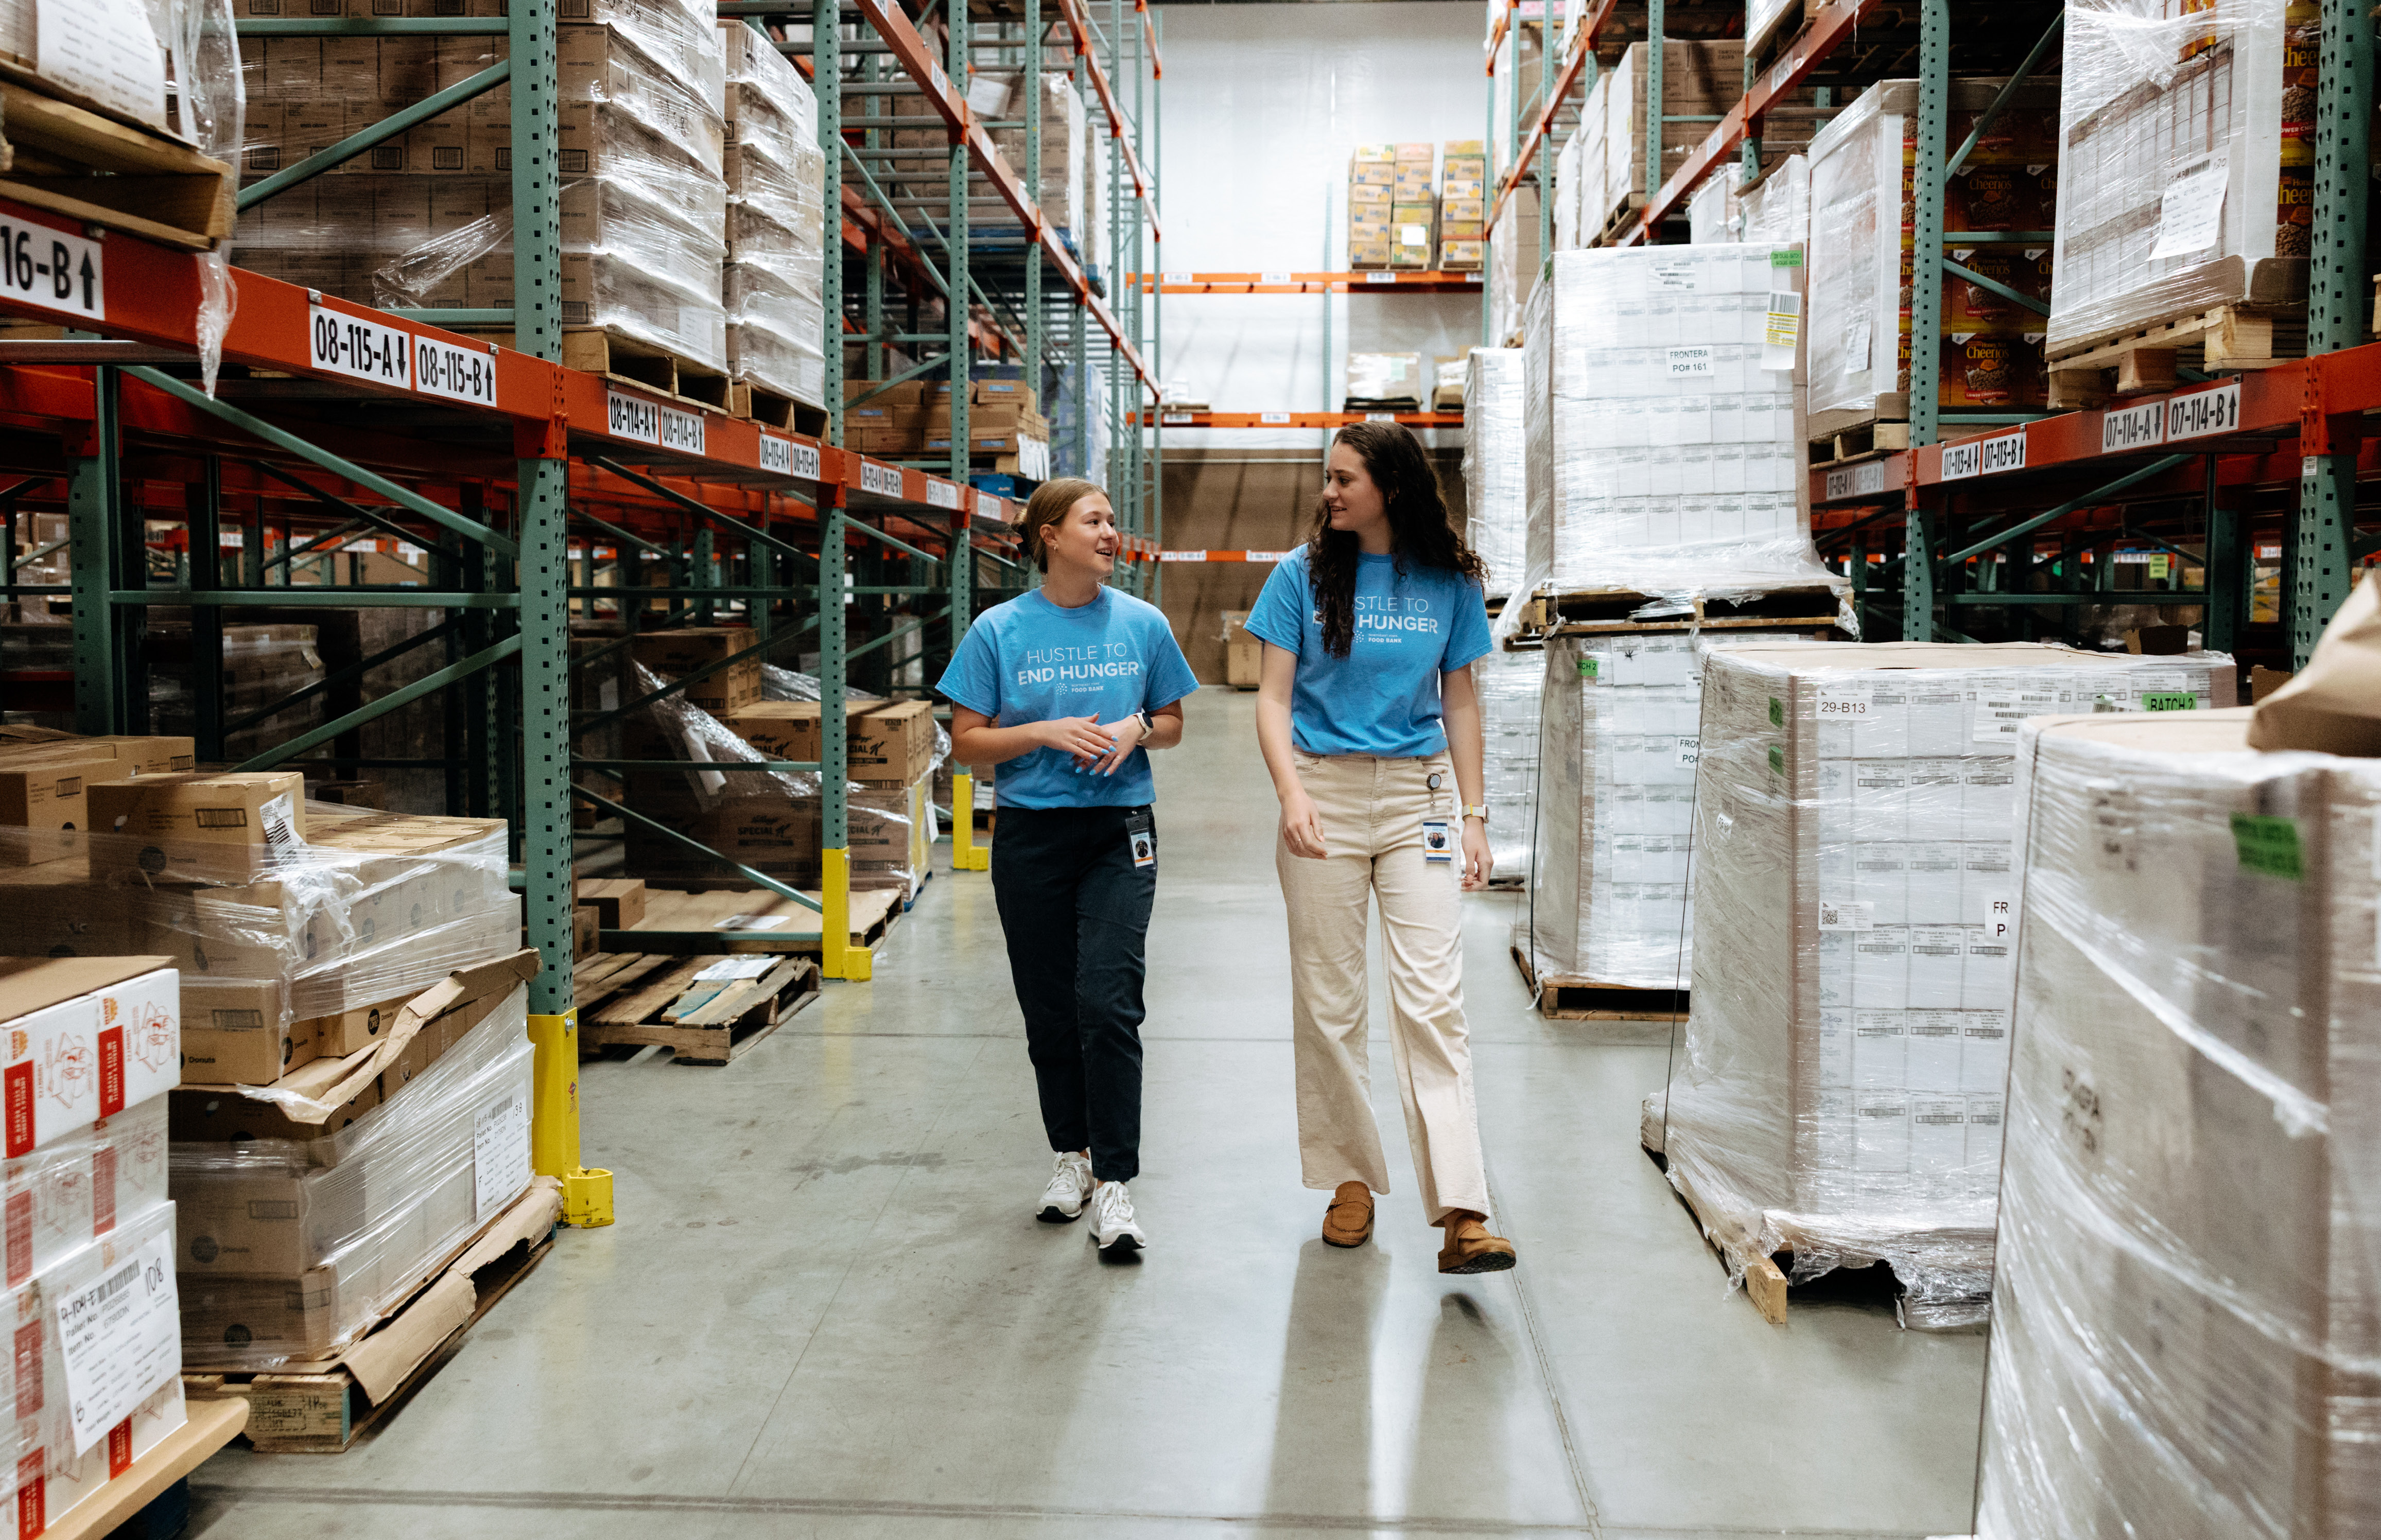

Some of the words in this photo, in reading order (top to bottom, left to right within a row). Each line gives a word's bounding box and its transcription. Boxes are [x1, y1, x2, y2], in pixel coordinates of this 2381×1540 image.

[1969, 178, 2012, 190] Cheerios
[2292, 178, 2312, 186] Hone
[1967, 262, 2010, 274] Cheerios
[316, 314, 393, 377] 08-115-A
[1670, 349, 1708, 359] FRONTERA
[1966, 346, 2009, 359] Cheerios
[419, 343, 482, 396] 08-115-B
[1673, 363, 1690, 372] PO#
[1693, 362, 1707, 371] 161
[610, 396, 651, 437] 08-114-A
[2171, 394, 2224, 436] 07-114-B
[663, 412, 697, 448] 08-114-B
[2106, 409, 2150, 447] 07-114-A
[761, 439, 785, 469] 08-113-A
[793, 446, 815, 474] 08-113-B
[1944, 448, 1972, 476] 07-113-A
[1985, 439, 2017, 469] 07-113-B
[1829, 474, 1848, 497] 07-112-A
[1355, 596, 1398, 611] STLE
[1404, 598, 1429, 613] TO
[1359, 614, 1438, 634] HUNGER
[1028, 645, 1097, 664] HUSTLE
[1103, 642, 1127, 657] TO
[1018, 668, 1055, 686] END
[1060, 661, 1139, 680] HUNGER
[1821, 702, 1866, 713] 29-B13
[2150, 697, 2186, 711] BATCH
[2187, 697, 2194, 710] 2
[848, 745, 868, 753] CIAL
[1680, 739, 1699, 748] FRON
[738, 827, 773, 835] SPECIAL
[847, 826, 869, 834] ECIAL
[381, 1011, 393, 1022] Donuts
[294, 1038, 308, 1049] Donuts
[476, 1127, 486, 1140] Pallet
[476, 1140, 484, 1151] Item
[145, 1256, 164, 1297] 108
[65, 1319, 86, 1339] Pallet
[86, 1312, 99, 1325] No.
[68, 1340, 83, 1356] Item
[84, 1332, 96, 1344] No.
